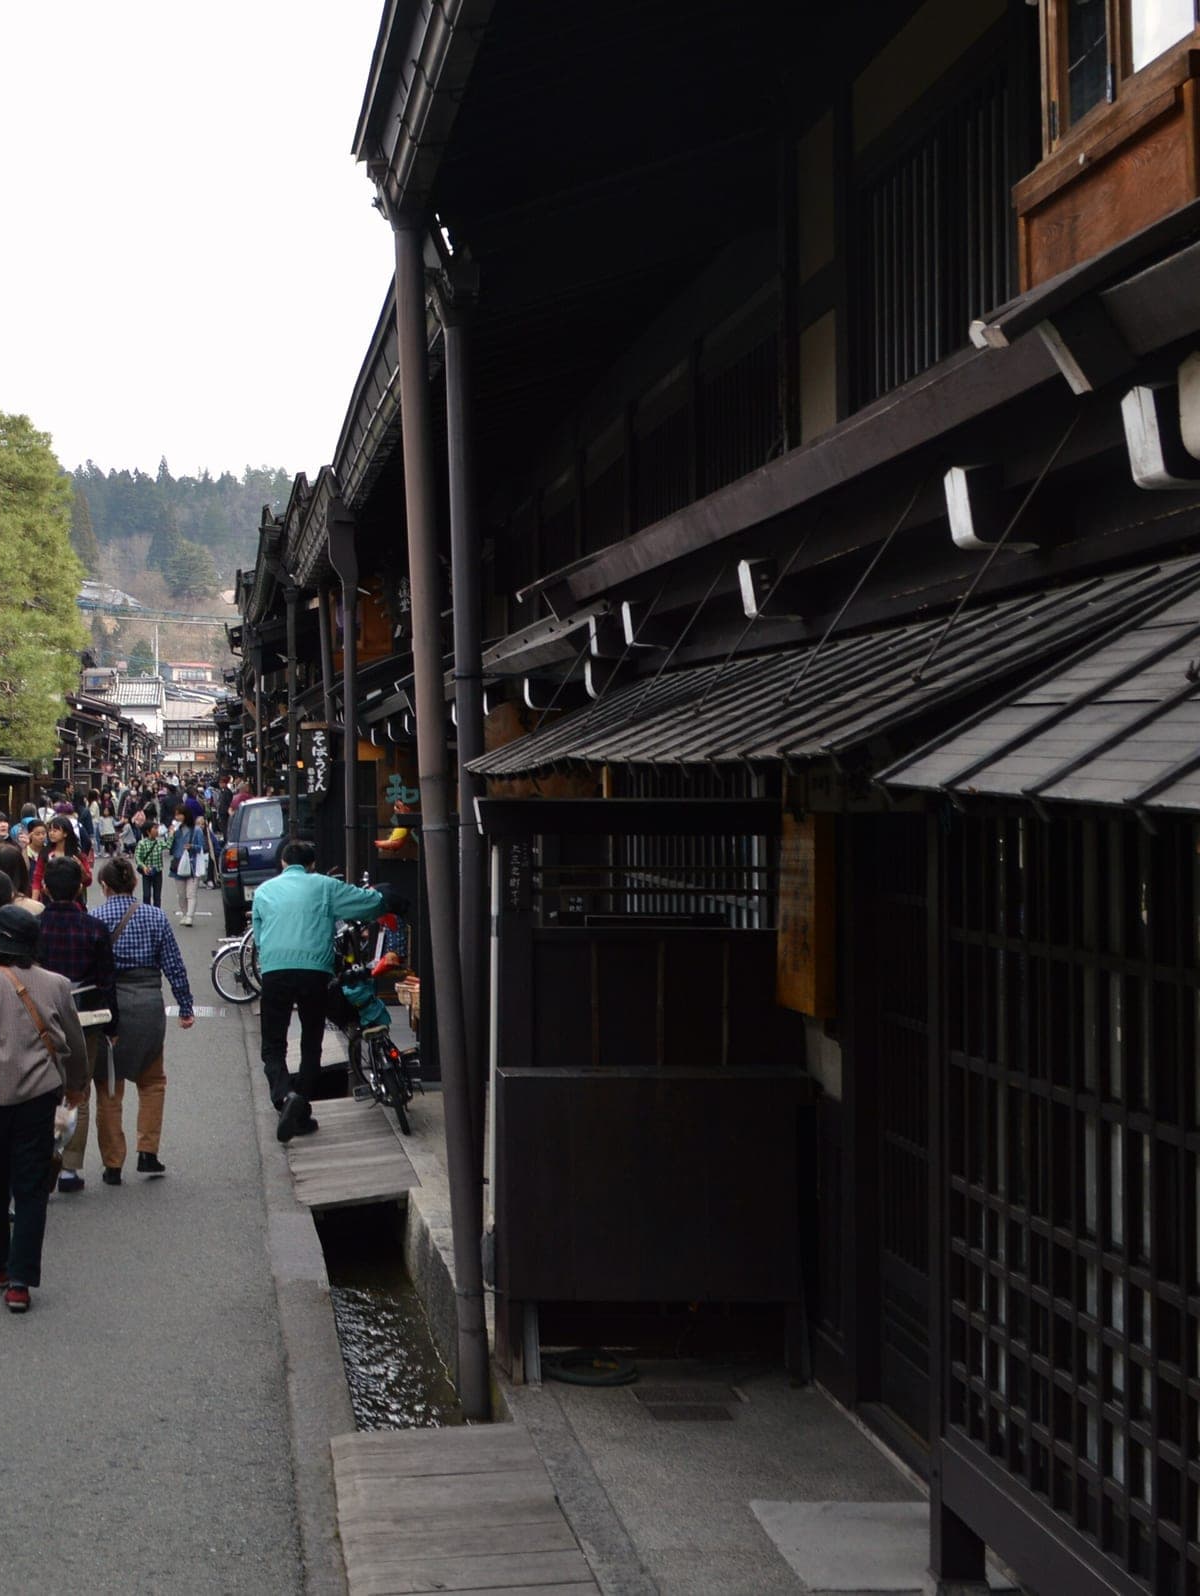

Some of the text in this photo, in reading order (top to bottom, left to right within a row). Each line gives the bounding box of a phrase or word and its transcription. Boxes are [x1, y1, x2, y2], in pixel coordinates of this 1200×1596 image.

[312, 730, 328, 791] そばうどん
